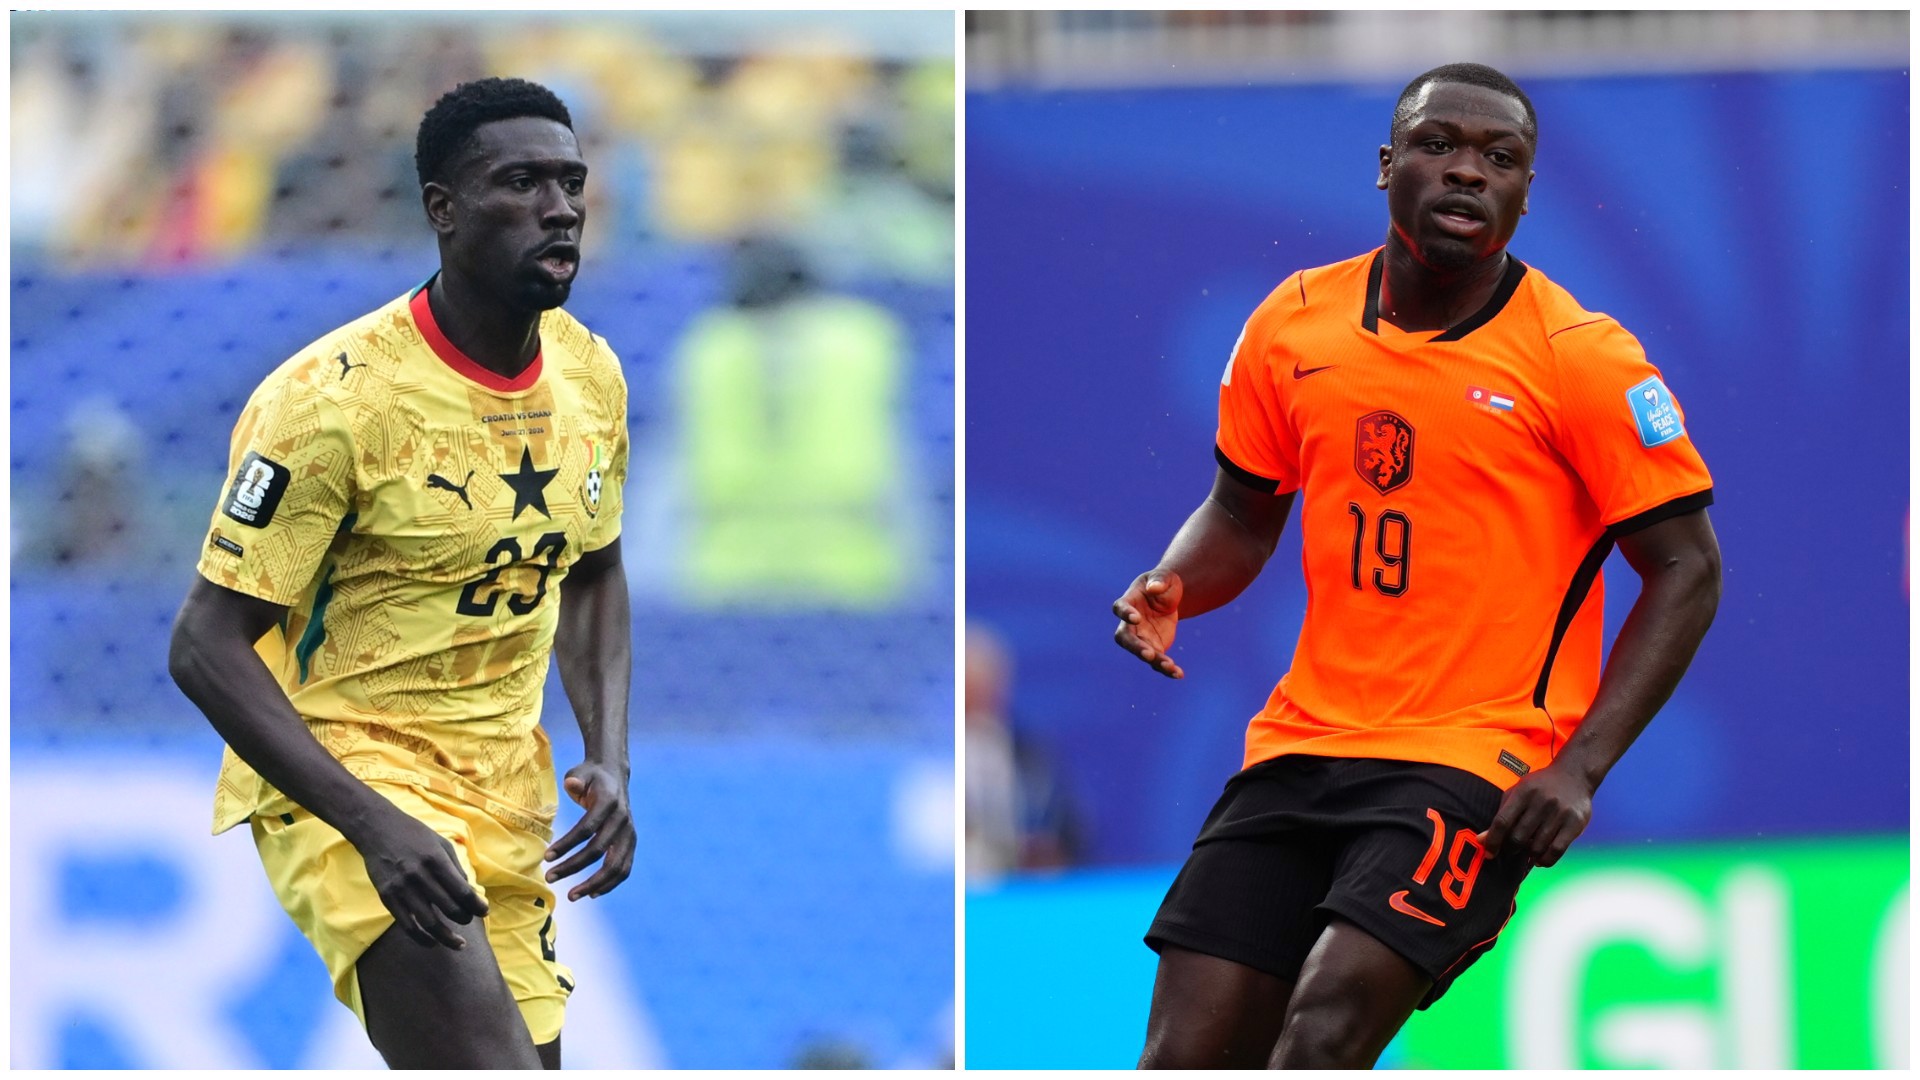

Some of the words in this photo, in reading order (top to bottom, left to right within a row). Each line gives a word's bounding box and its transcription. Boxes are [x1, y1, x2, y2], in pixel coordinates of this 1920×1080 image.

[481, 413, 515, 423] CROATIA
[517, 412, 527, 420] VS
[1652, 414, 1675, 432] PEACE
[241, 494, 255, 504] FIFA
[229, 505, 256, 522] 2026
[218, 538, 242, 552] DEBUT
[1348, 501, 1412, 598] 19
[455, 531, 568, 617] 23
[1411, 807, 1486, 910] 19
